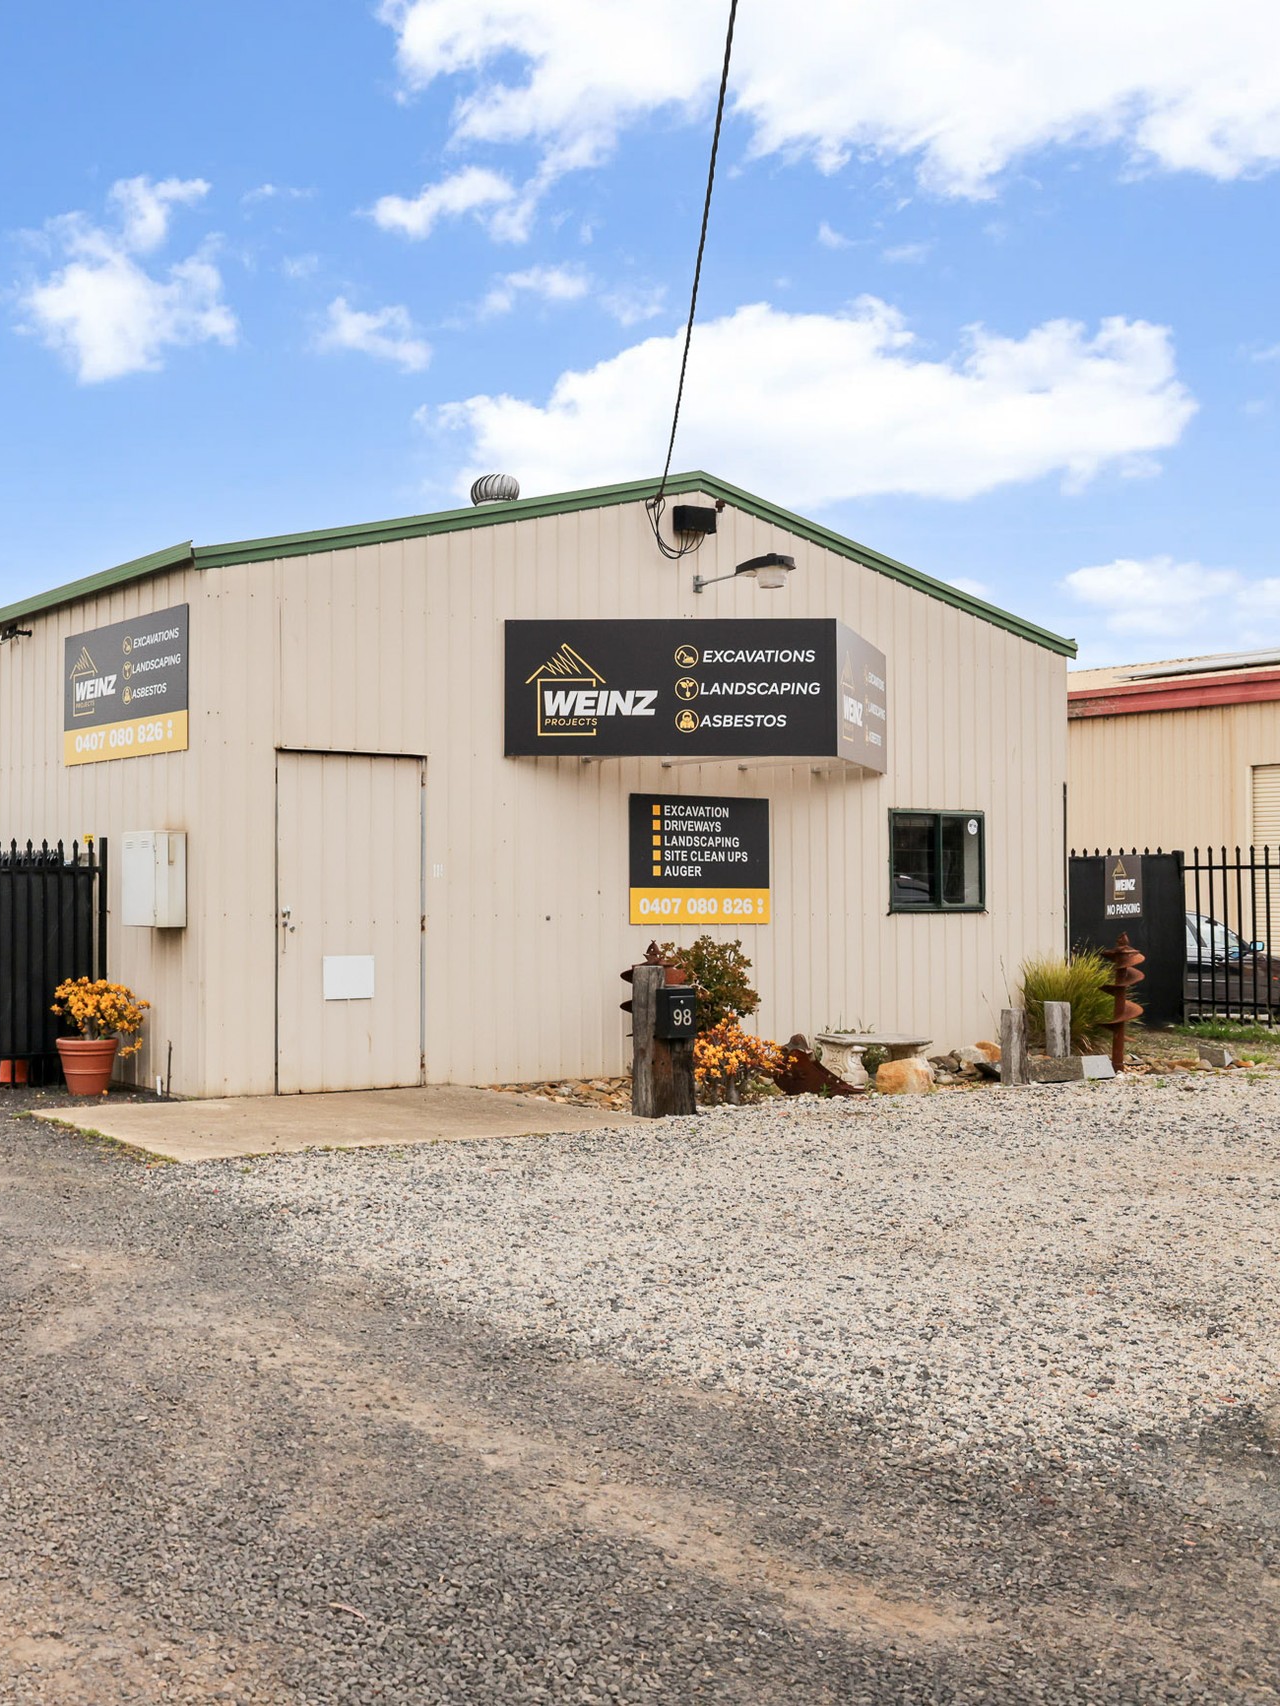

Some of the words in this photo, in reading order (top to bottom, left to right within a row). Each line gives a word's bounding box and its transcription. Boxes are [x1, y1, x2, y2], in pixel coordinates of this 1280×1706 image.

[133, 627, 180, 649] EXCAVATIONS
[702, 649, 816, 663] EXCAVATIONS
[132, 653, 181, 675] LANDSCAPING
[75, 674, 117, 702] WEINZ
[131, 682, 168, 700] ASBESTOS
[700, 682, 821, 695] LANDSCAPING
[543, 690, 659, 716] WEINZ
[544, 718, 598, 726] PROJECTS
[699, 714, 787, 728] ASBESTOS
[75, 731, 106, 753] 0407
[109, 727, 134, 748] 080
[137, 721, 164, 744] 826
[664, 805, 730, 818] EXCAVATION
[664, 820, 722, 832] DRIVEWAYS
[664, 836, 740, 848] LANDSCAPING
[664, 850, 688, 861] SITE
[690, 851, 725, 862] CLEAN
[727, 852, 748, 862] UPS
[664, 865, 702, 877] AUGER
[1115, 879, 1136, 891] WEINZ
[639, 897, 682, 915] 0407
[686, 897, 718, 915] 080
[722, 897, 753, 915] 826
[1107, 905, 1115, 916] NO
[1116, 903, 1141, 915] PARKING
[673, 1009, 692, 1026] 98
